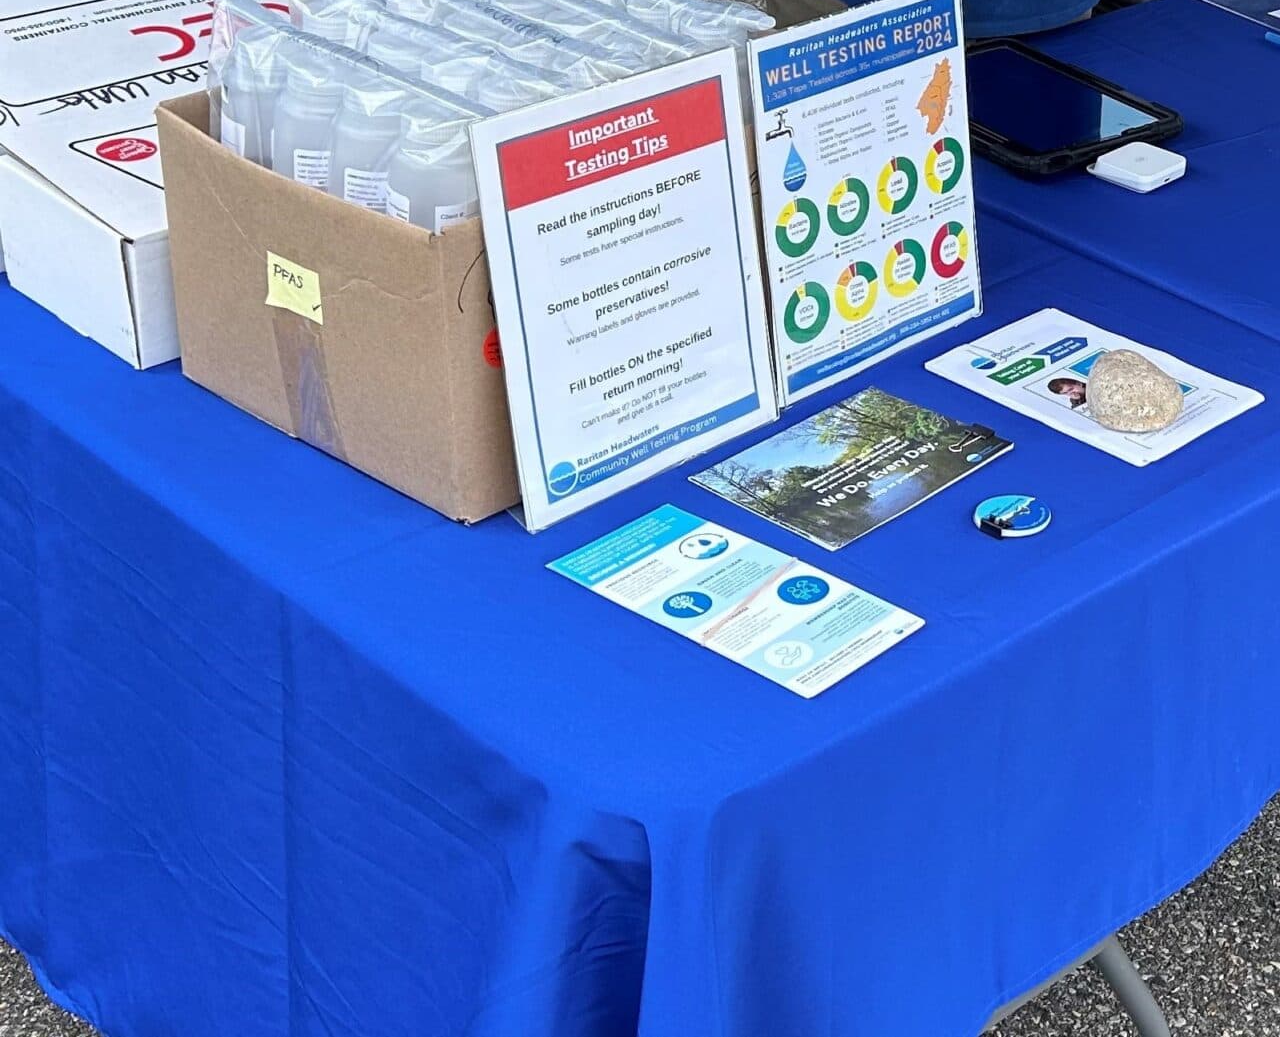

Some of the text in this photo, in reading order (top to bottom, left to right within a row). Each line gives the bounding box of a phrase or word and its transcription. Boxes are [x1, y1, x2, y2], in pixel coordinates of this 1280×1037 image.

[13, 21, 89, 42] CONTAINERS
[94, 1, 188, 26] ENVIRONMENTAL
[788, 3, 931, 57] Raritan Headwaters Association
[765, 11, 951, 87] WELL TESTING REPORT
[916, 28, 952, 54] 2024
[567, 105, 655, 151] Important
[564, 129, 669, 182] Testing Tips
[536, 168, 701, 235] Read the instructions BEFORE
[586, 203, 661, 241] sampling day!
[559, 251, 581, 267] Some
[600, 238, 618, 252] have
[619, 229, 643, 246] special
[272, 263, 304, 289] PFAS
[546, 243, 711, 316] Some bottles contain corrosive
[594, 279, 669, 320] preservatives!
[566, 328, 597, 348] Warning
[598, 319, 618, 334] labels
[619, 313, 633, 325] and
[634, 304, 656, 321] gloves
[657, 300, 669, 310] are
[569, 325, 712, 395] Fill bottles ON the specified
[602, 357, 683, 401] return morning!
[581, 414, 600, 429] Can't
[631, 396, 641, 407] Do
[641, 389, 657, 402] NOT
[666, 378, 682, 392] your
[617, 412, 629, 424] and
[630, 405, 644, 419] give
[576, 422, 659, 468] Raritan Headwaters
[579, 411, 717, 486] Community Well Testing Program
[816, 441, 939, 508] We Do. Every Day.
